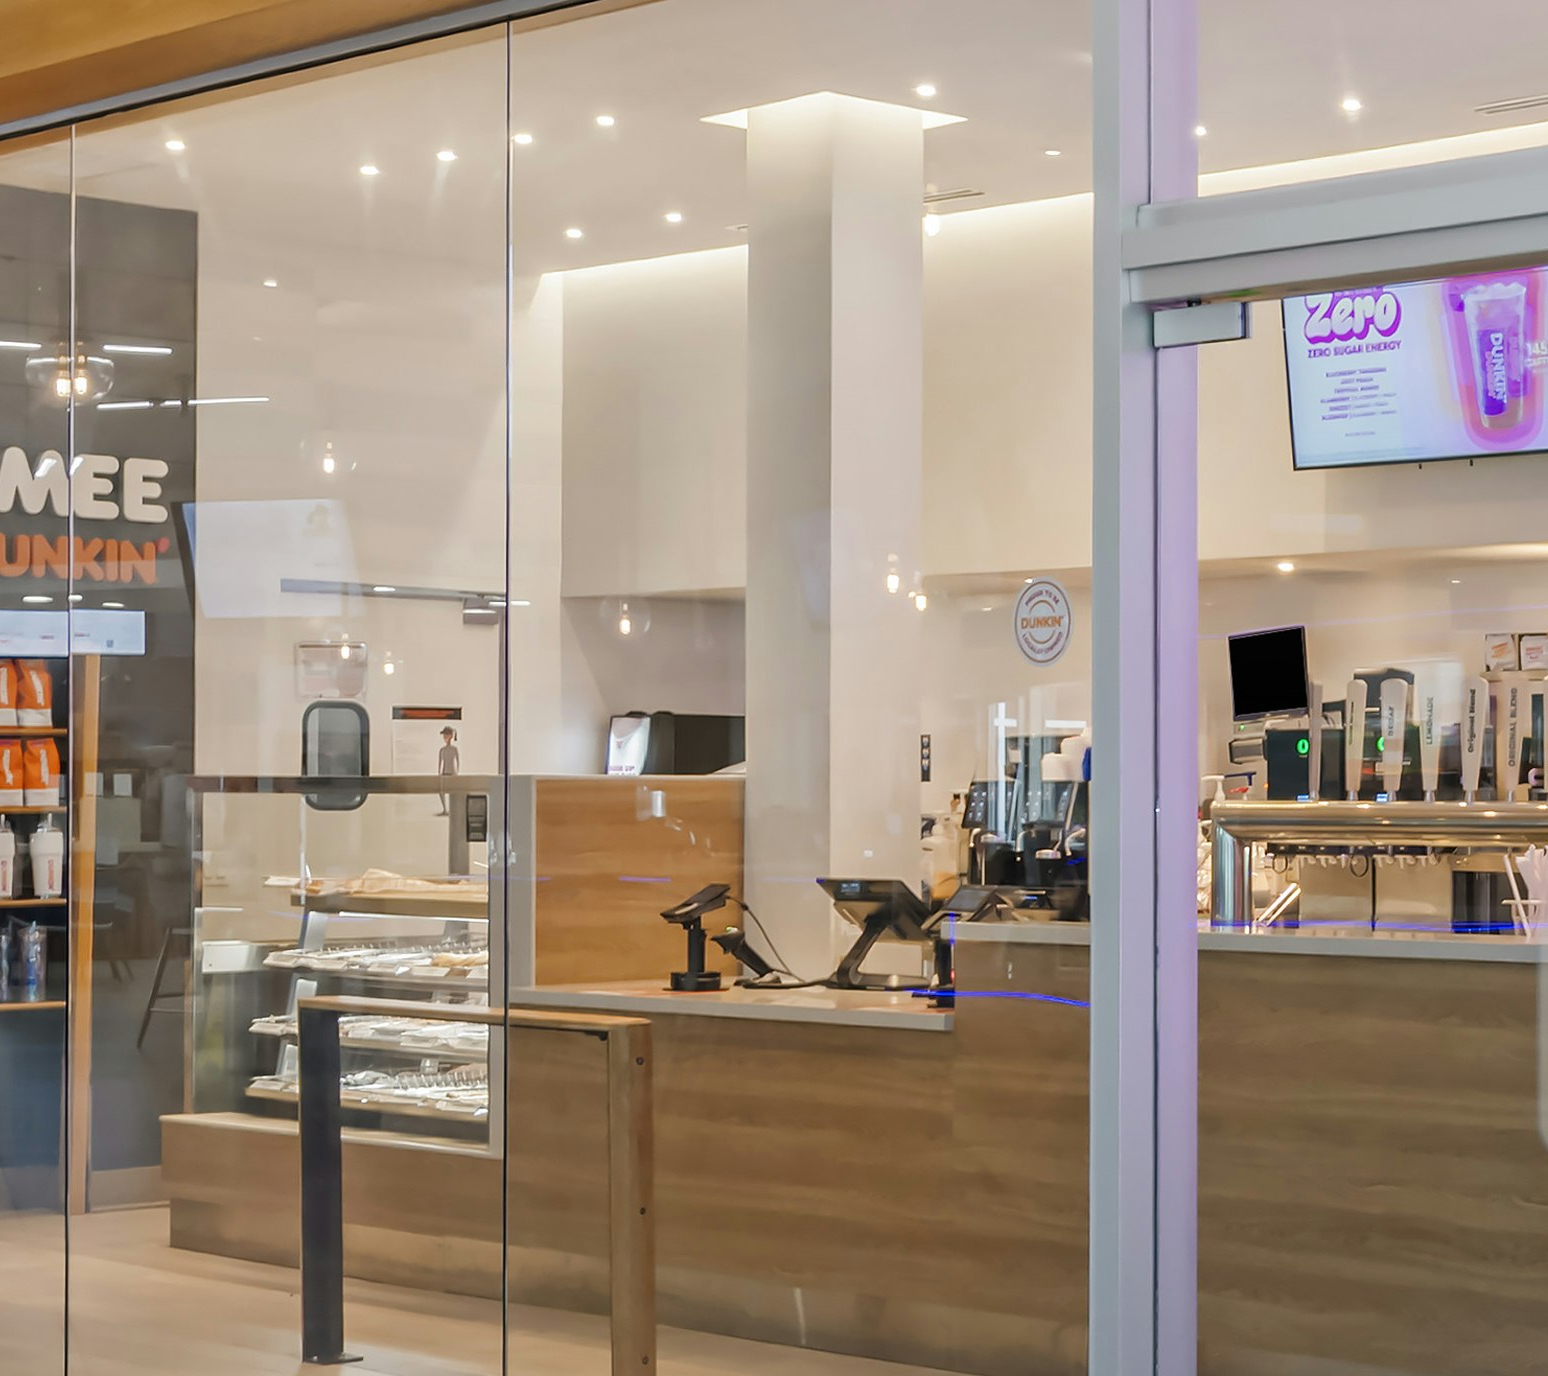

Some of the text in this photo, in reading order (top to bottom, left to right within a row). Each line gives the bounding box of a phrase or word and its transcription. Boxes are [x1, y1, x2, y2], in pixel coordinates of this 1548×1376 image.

[1303, 291, 1402, 345] Zero
[1307, 347, 1332, 359] ZERO
[1020, 615, 1064, 629] DUNKIN'
